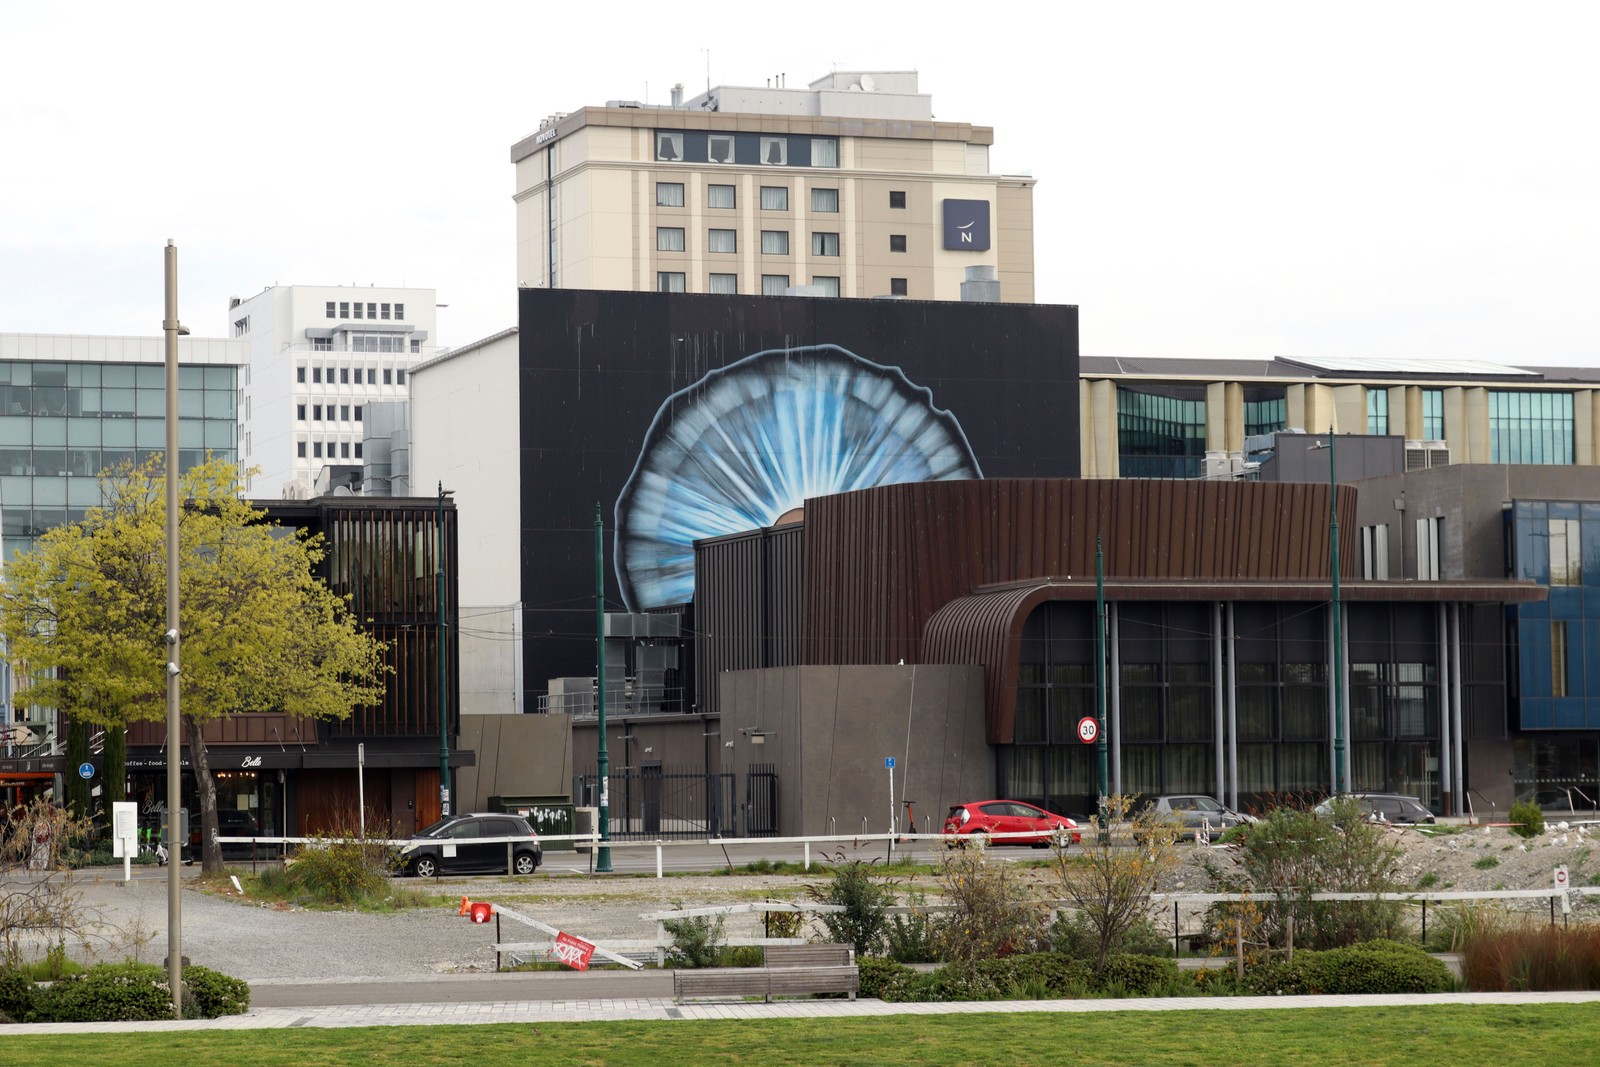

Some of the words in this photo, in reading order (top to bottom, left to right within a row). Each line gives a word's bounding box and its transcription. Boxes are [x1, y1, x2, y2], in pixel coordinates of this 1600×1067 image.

[961, 231, 972, 243] N
[1082, 725, 1095, 735] 30
[241, 755, 262, 768] Belle
